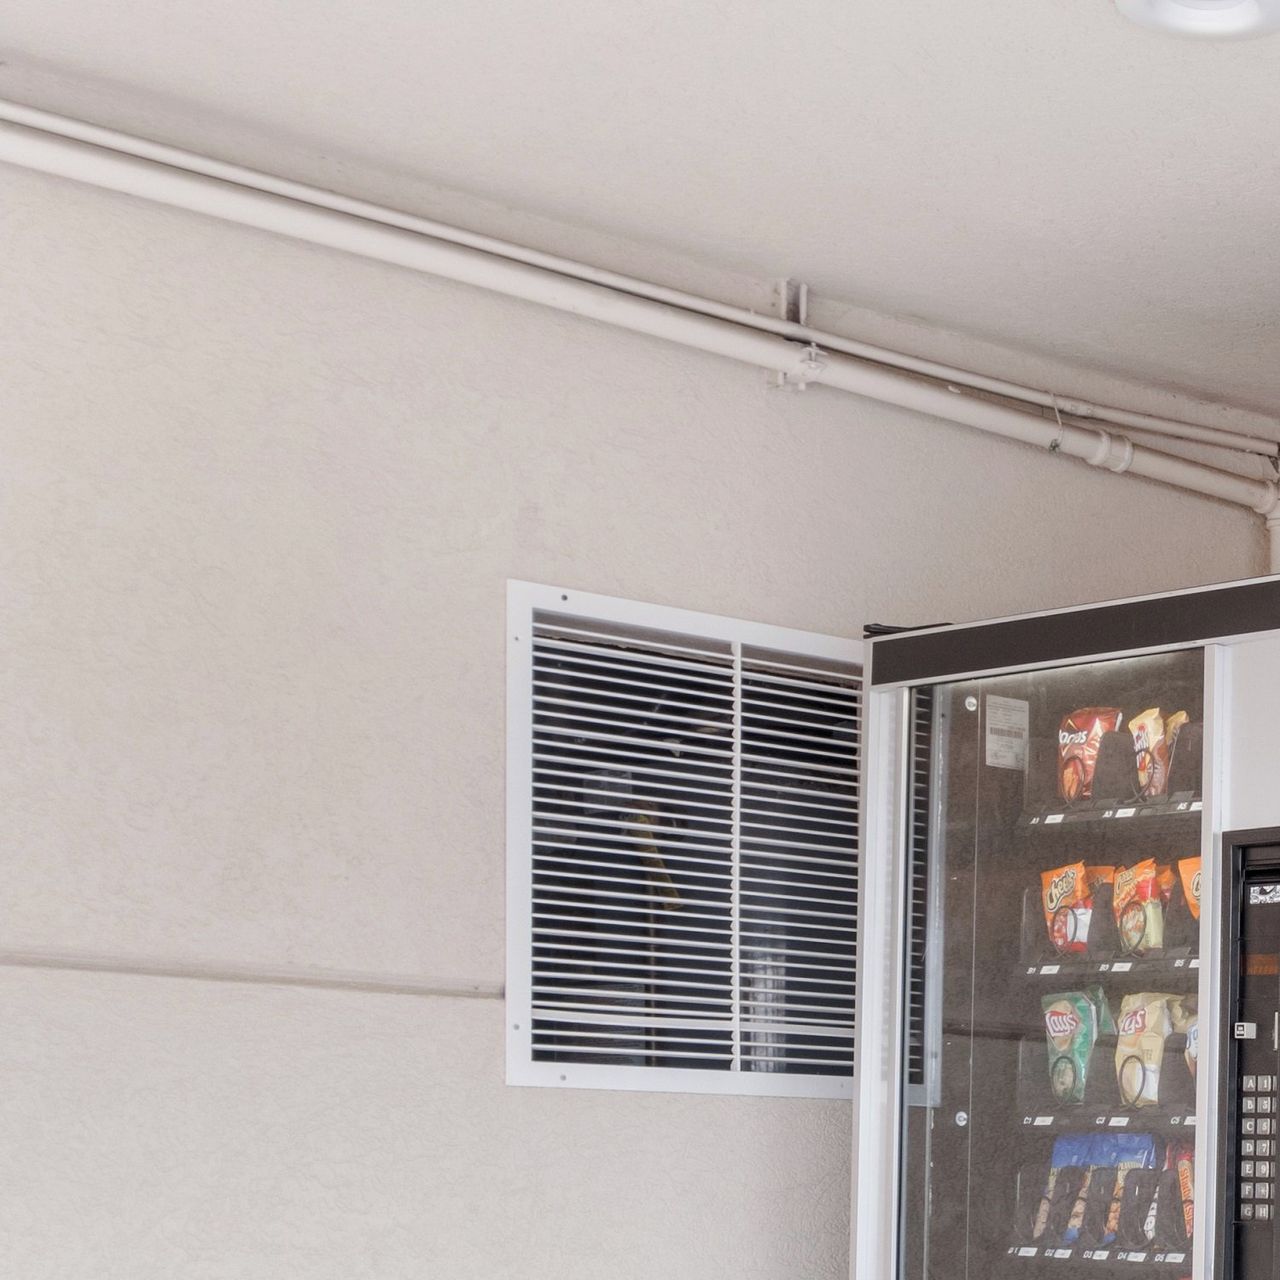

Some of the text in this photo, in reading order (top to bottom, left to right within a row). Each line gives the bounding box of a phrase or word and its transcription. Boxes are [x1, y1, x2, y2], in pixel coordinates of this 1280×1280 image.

[1247, 1080, 1254, 1088] A
[1247, 1100, 1254, 1110] B
[1246, 1122, 1253, 1131] C
[1246, 1144, 1252, 1152] D
[1246, 1165, 1252, 1174] E
[1245, 1186, 1251, 1195] F
[1260, 1208, 1266, 1216] H
